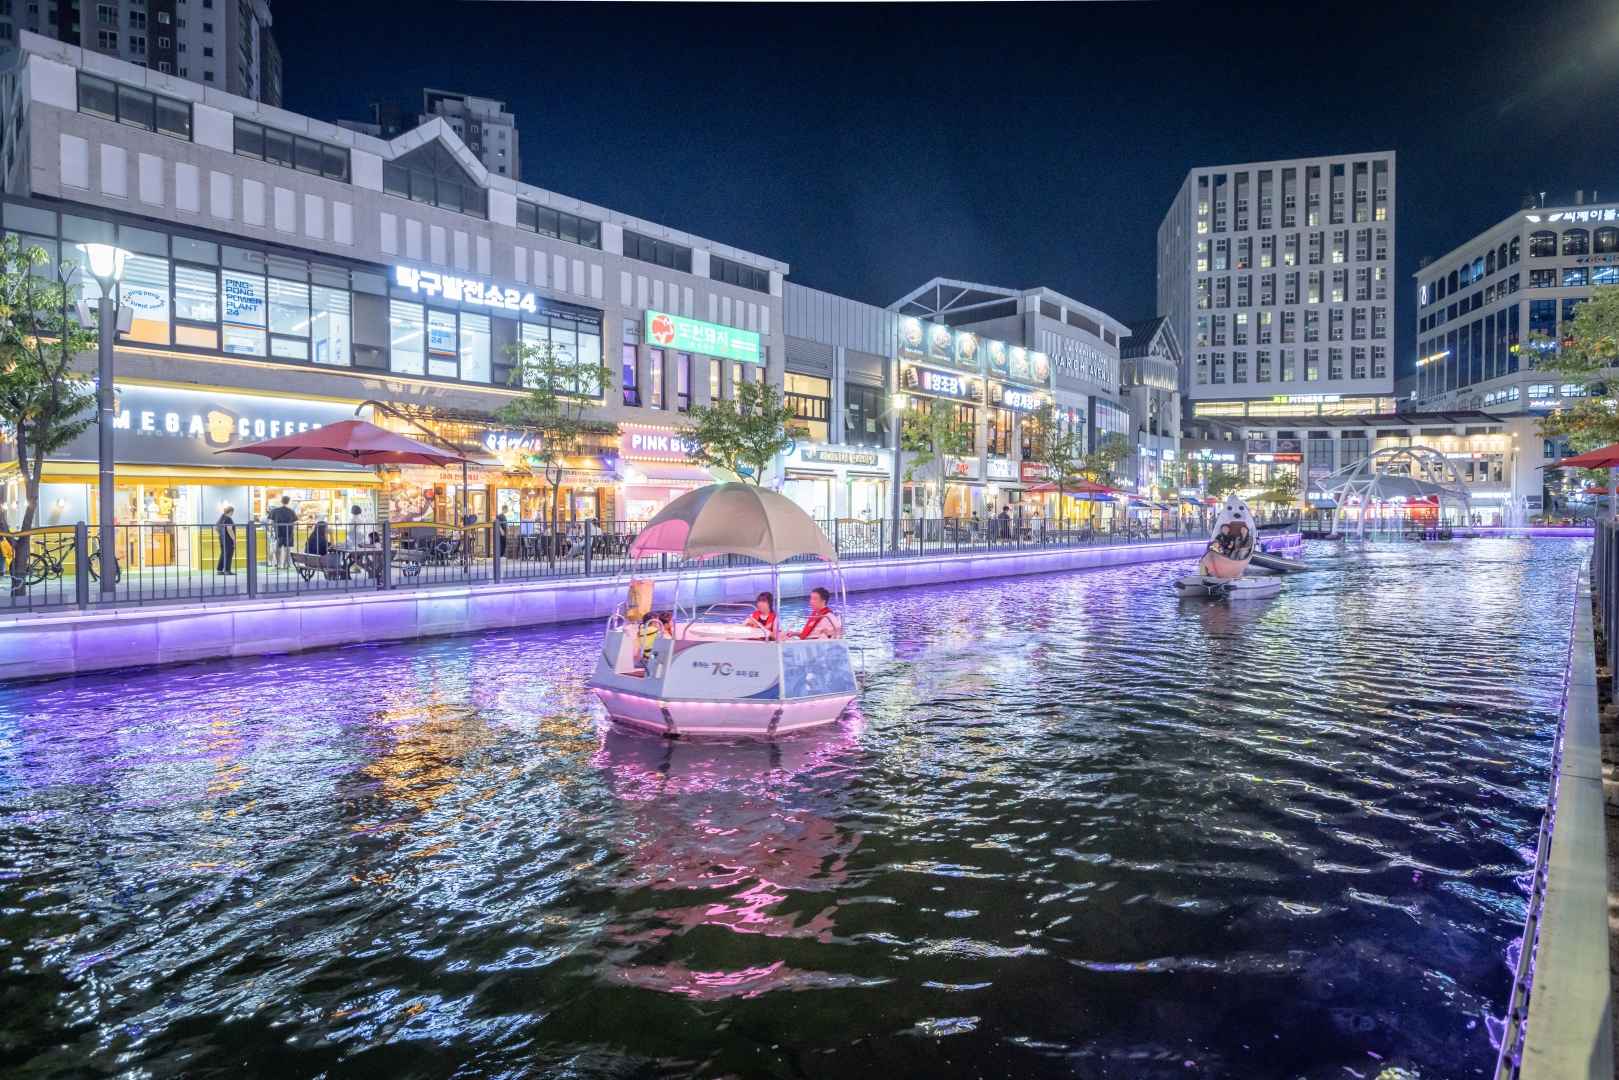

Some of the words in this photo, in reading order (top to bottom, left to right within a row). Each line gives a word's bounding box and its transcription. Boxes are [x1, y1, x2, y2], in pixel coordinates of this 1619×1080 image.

[226, 294, 262, 305] POWER
[226, 302, 258, 312] PLANT
[112, 409, 205, 434] MEGA
[631, 434, 668, 451] PINK
